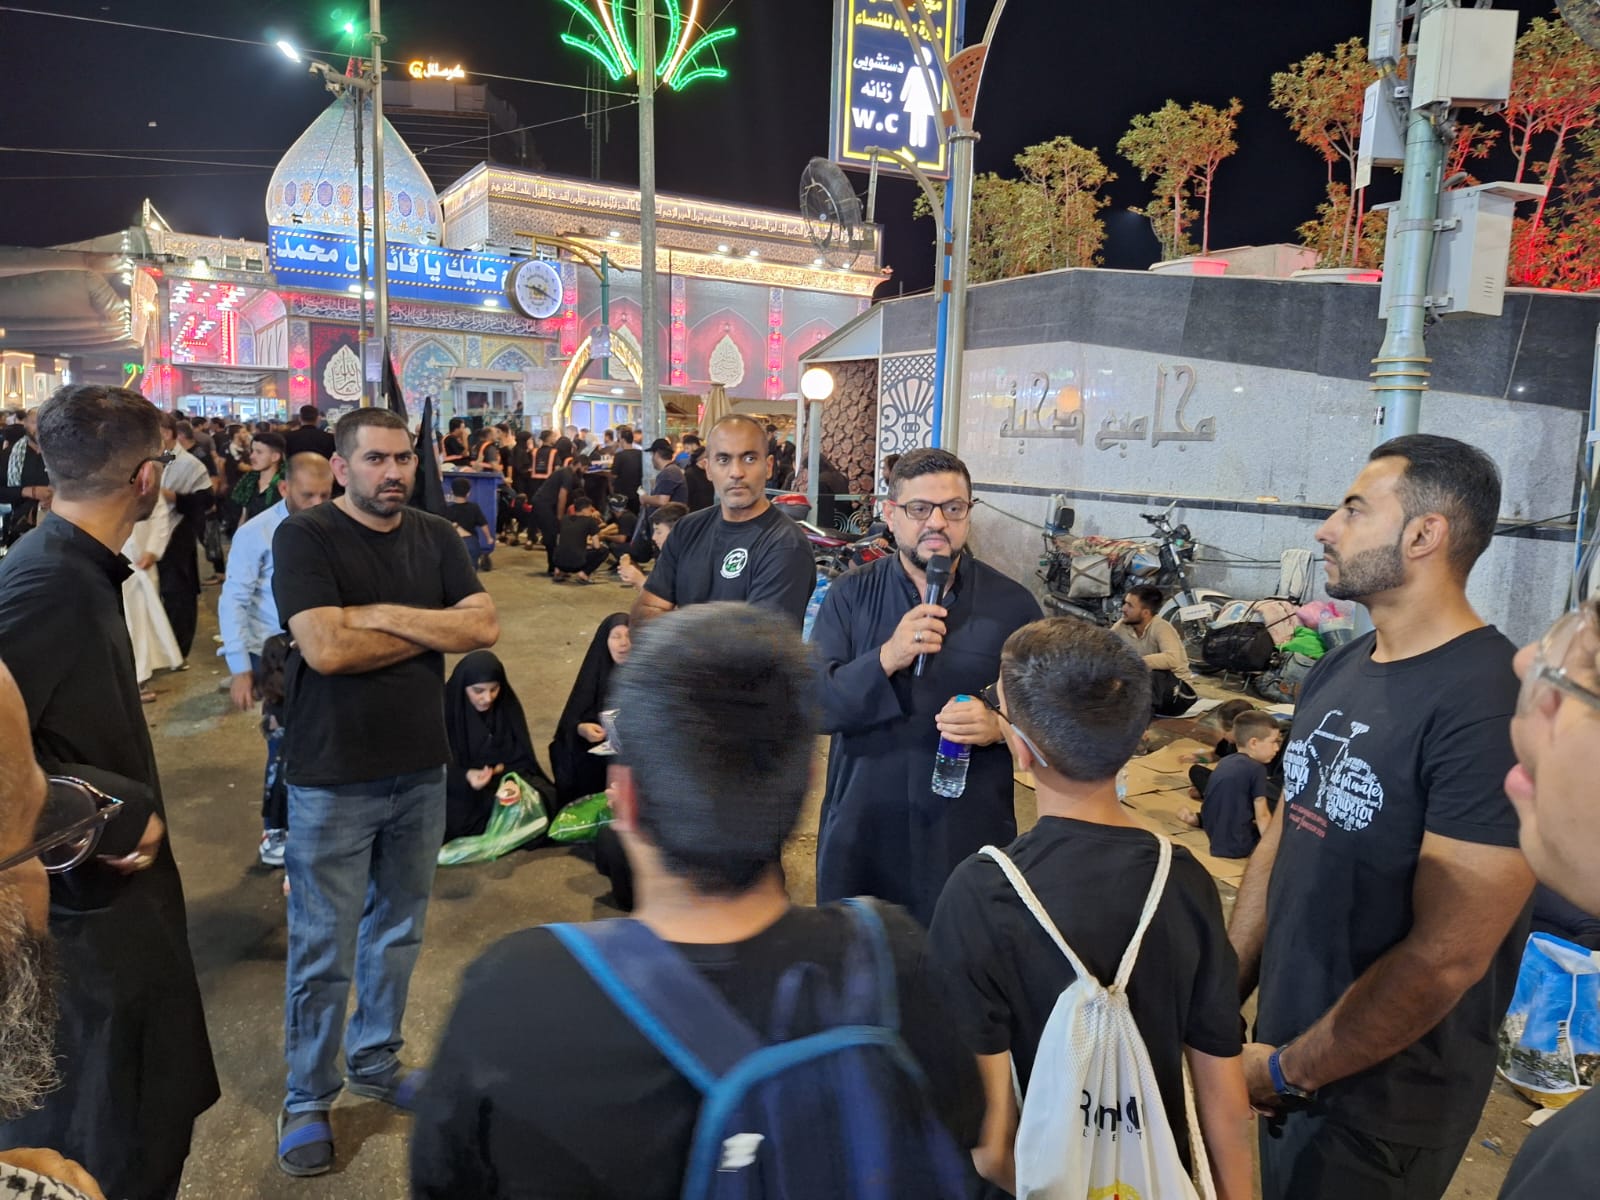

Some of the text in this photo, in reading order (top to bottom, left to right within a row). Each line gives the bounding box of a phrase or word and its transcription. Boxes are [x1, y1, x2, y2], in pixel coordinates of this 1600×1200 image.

[855, 9, 893, 30] للنساء
[861, 79, 893, 103] زنانه
[851, 107, 899, 133] W.C
[276, 238, 339, 263] محمد
[423, 251, 441, 283] يا
[445, 257, 497, 286] عليك
